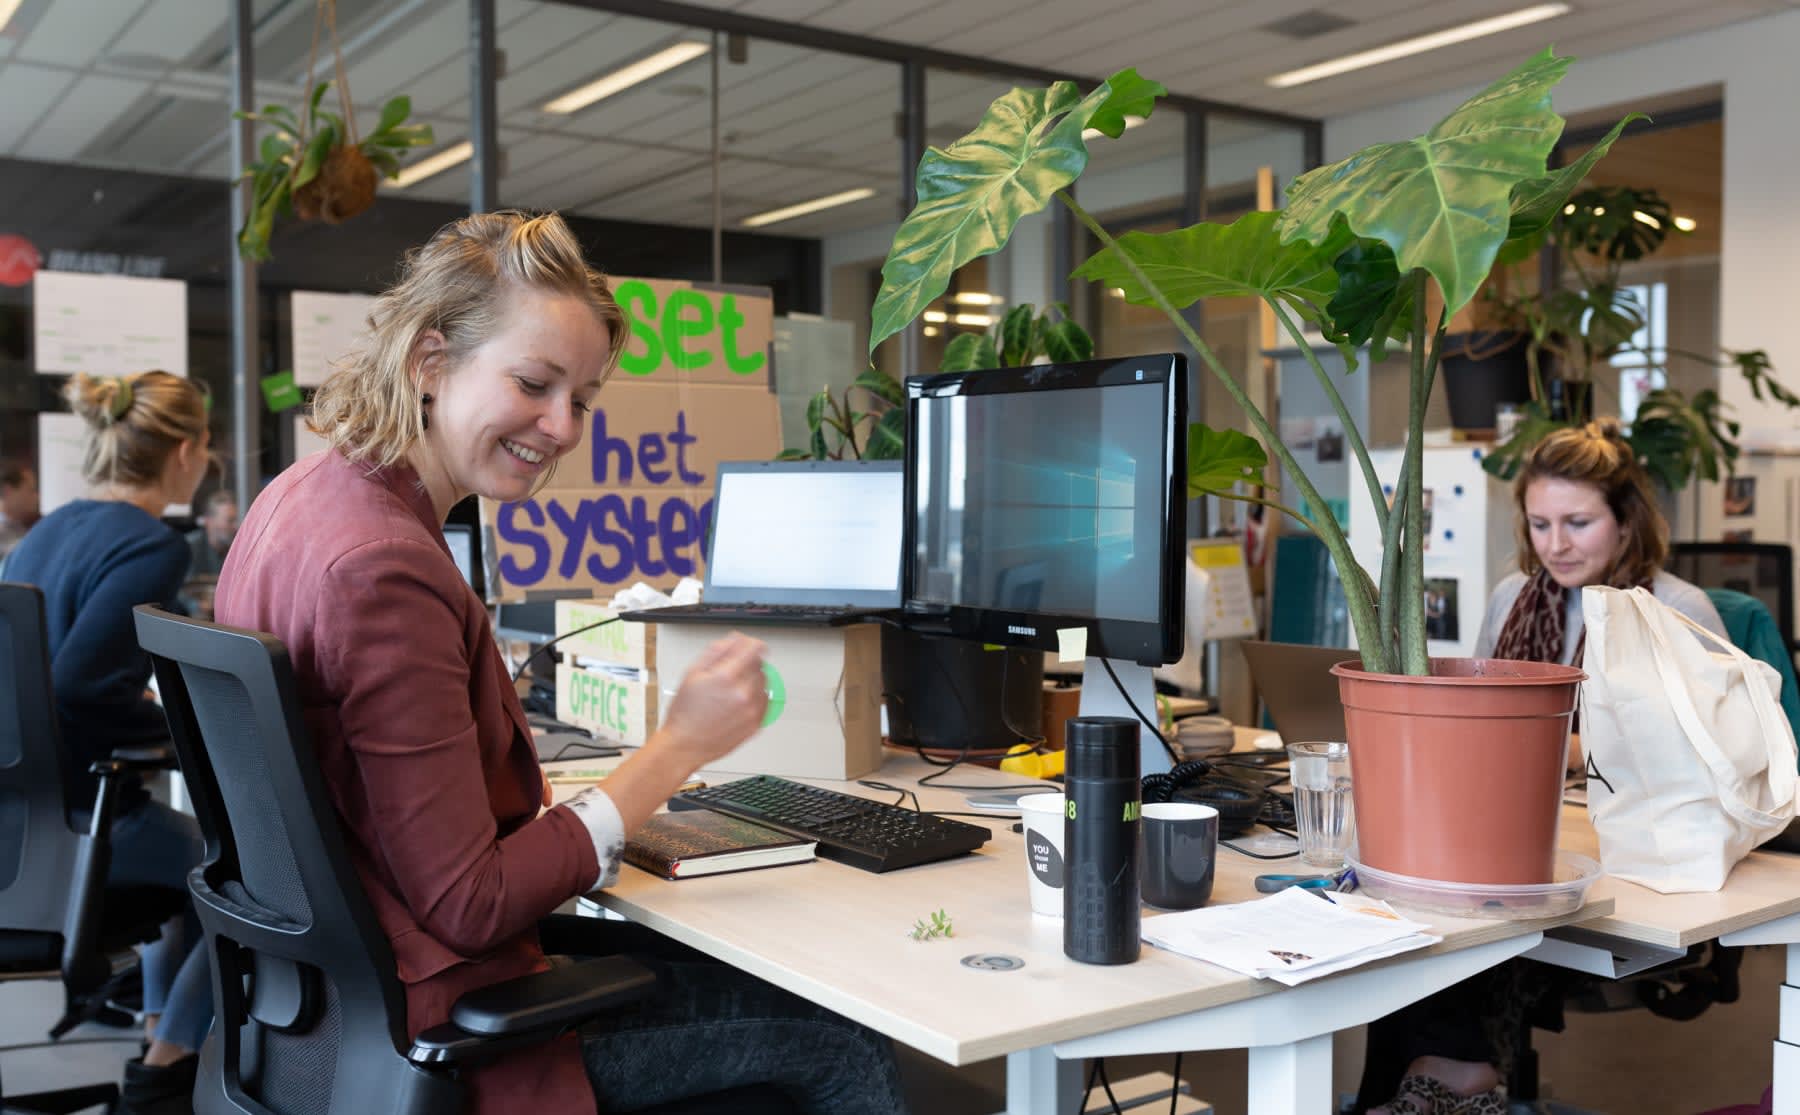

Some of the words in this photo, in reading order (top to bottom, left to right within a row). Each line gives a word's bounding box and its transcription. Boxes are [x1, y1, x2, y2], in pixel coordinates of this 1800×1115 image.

[592, 410, 705, 484] het
[497, 494, 713, 586] syste
[1008, 625, 1036, 636] SAMSUNG
[570, 672, 628, 732] OFFICE
[1033, 844, 1049, 855] YOU
[1036, 862, 1049, 873] ME
